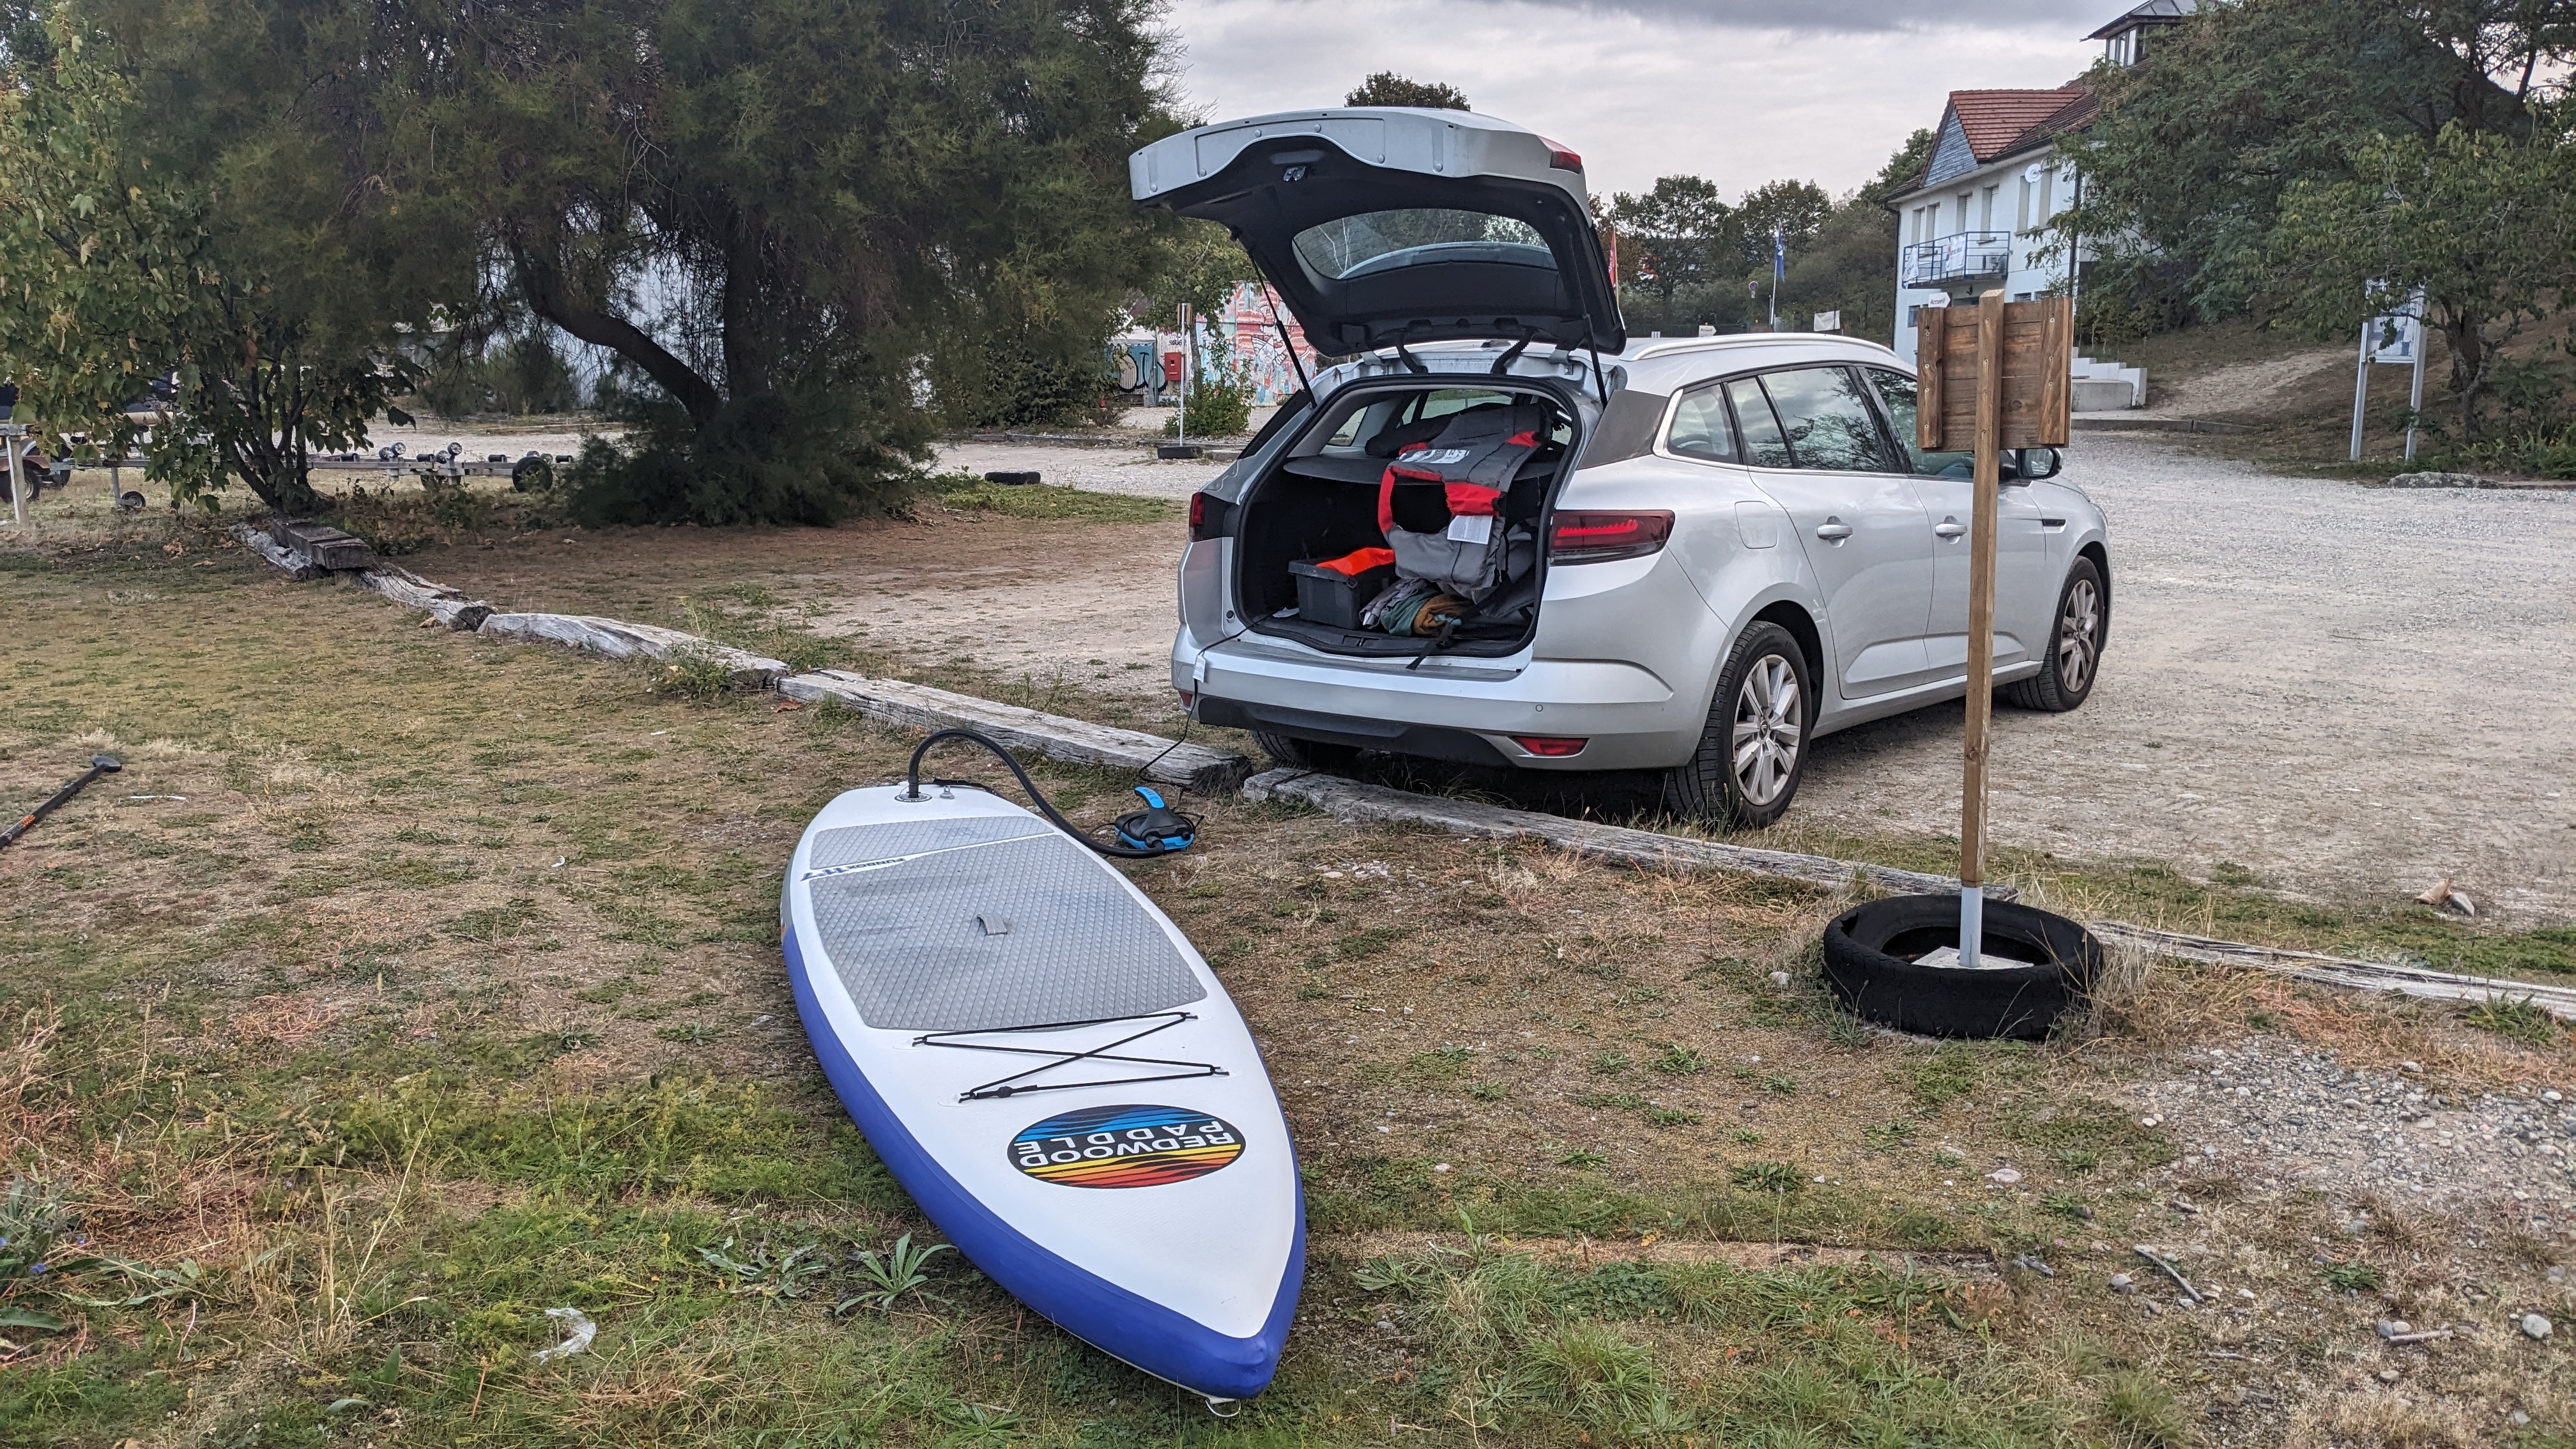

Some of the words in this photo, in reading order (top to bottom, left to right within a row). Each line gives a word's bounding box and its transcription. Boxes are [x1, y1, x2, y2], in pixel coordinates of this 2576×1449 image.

[847, 858, 905, 870] FUNBOX
[1014, 1121, 1223, 1154] PADDLE
[1020, 1133, 1235, 1167] REDWOOD
